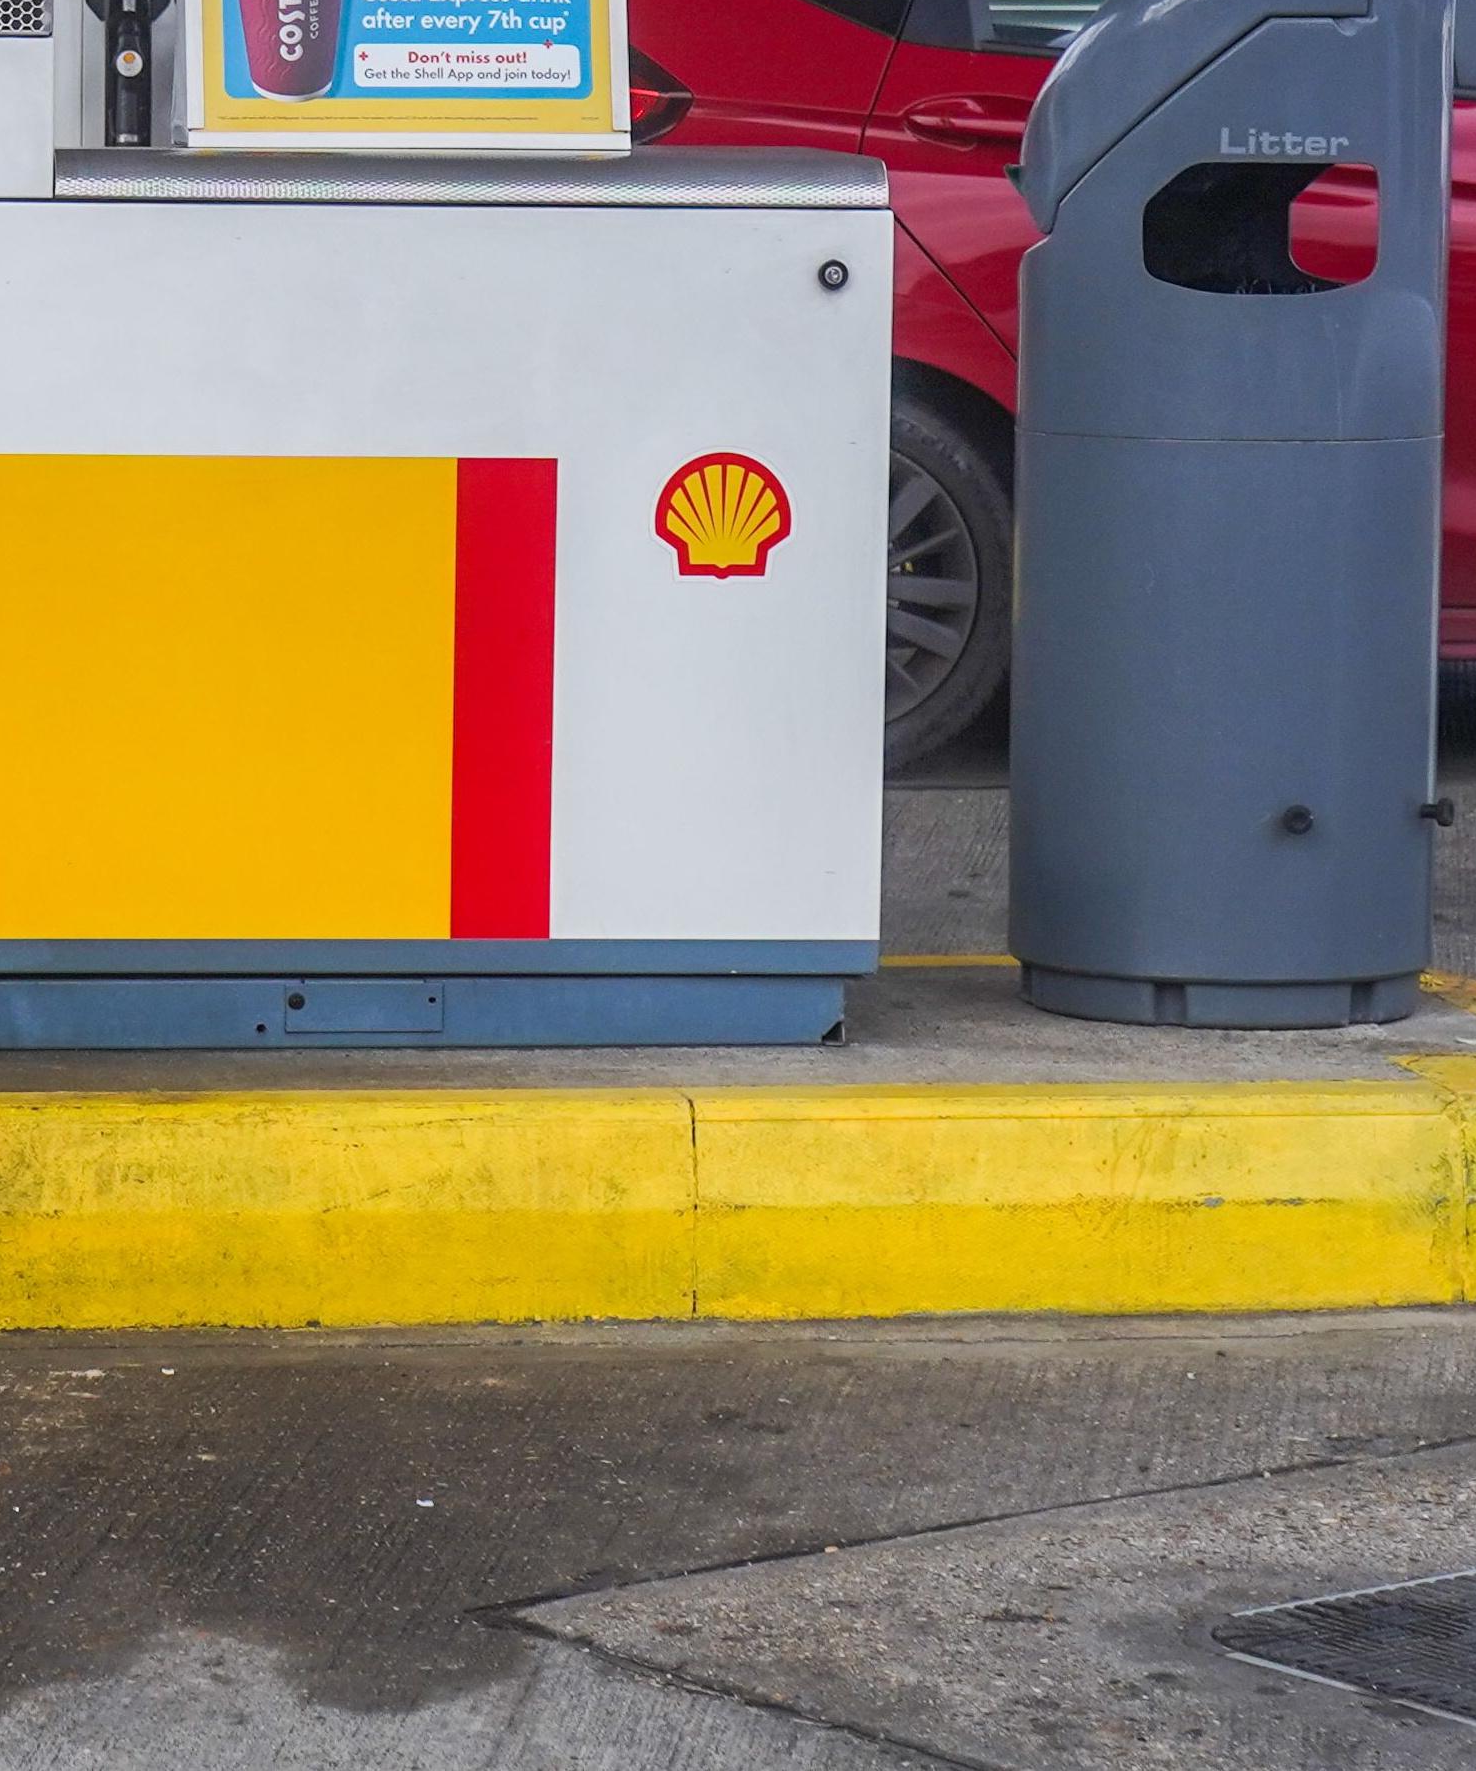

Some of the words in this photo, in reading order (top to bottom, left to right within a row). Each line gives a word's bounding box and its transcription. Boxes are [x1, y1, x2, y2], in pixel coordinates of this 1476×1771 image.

[362, 9, 416, 30] after
[421, 12, 483, 35] every
[488, 9, 522, 29] 7th
[408, 51, 453, 64] Don't
[457, 51, 490, 64] miss
[494, 51, 527, 64] out!
[364, 69, 388, 80] Get
[391, 69, 410, 80] the
[414, 68, 444, 80] Shell
[447, 69, 473, 83] App
[478, 68, 501, 80] and
[504, 68, 527, 83] join
[531, 68, 571, 83] today!
[1220, 127, 1349, 156] Litter
